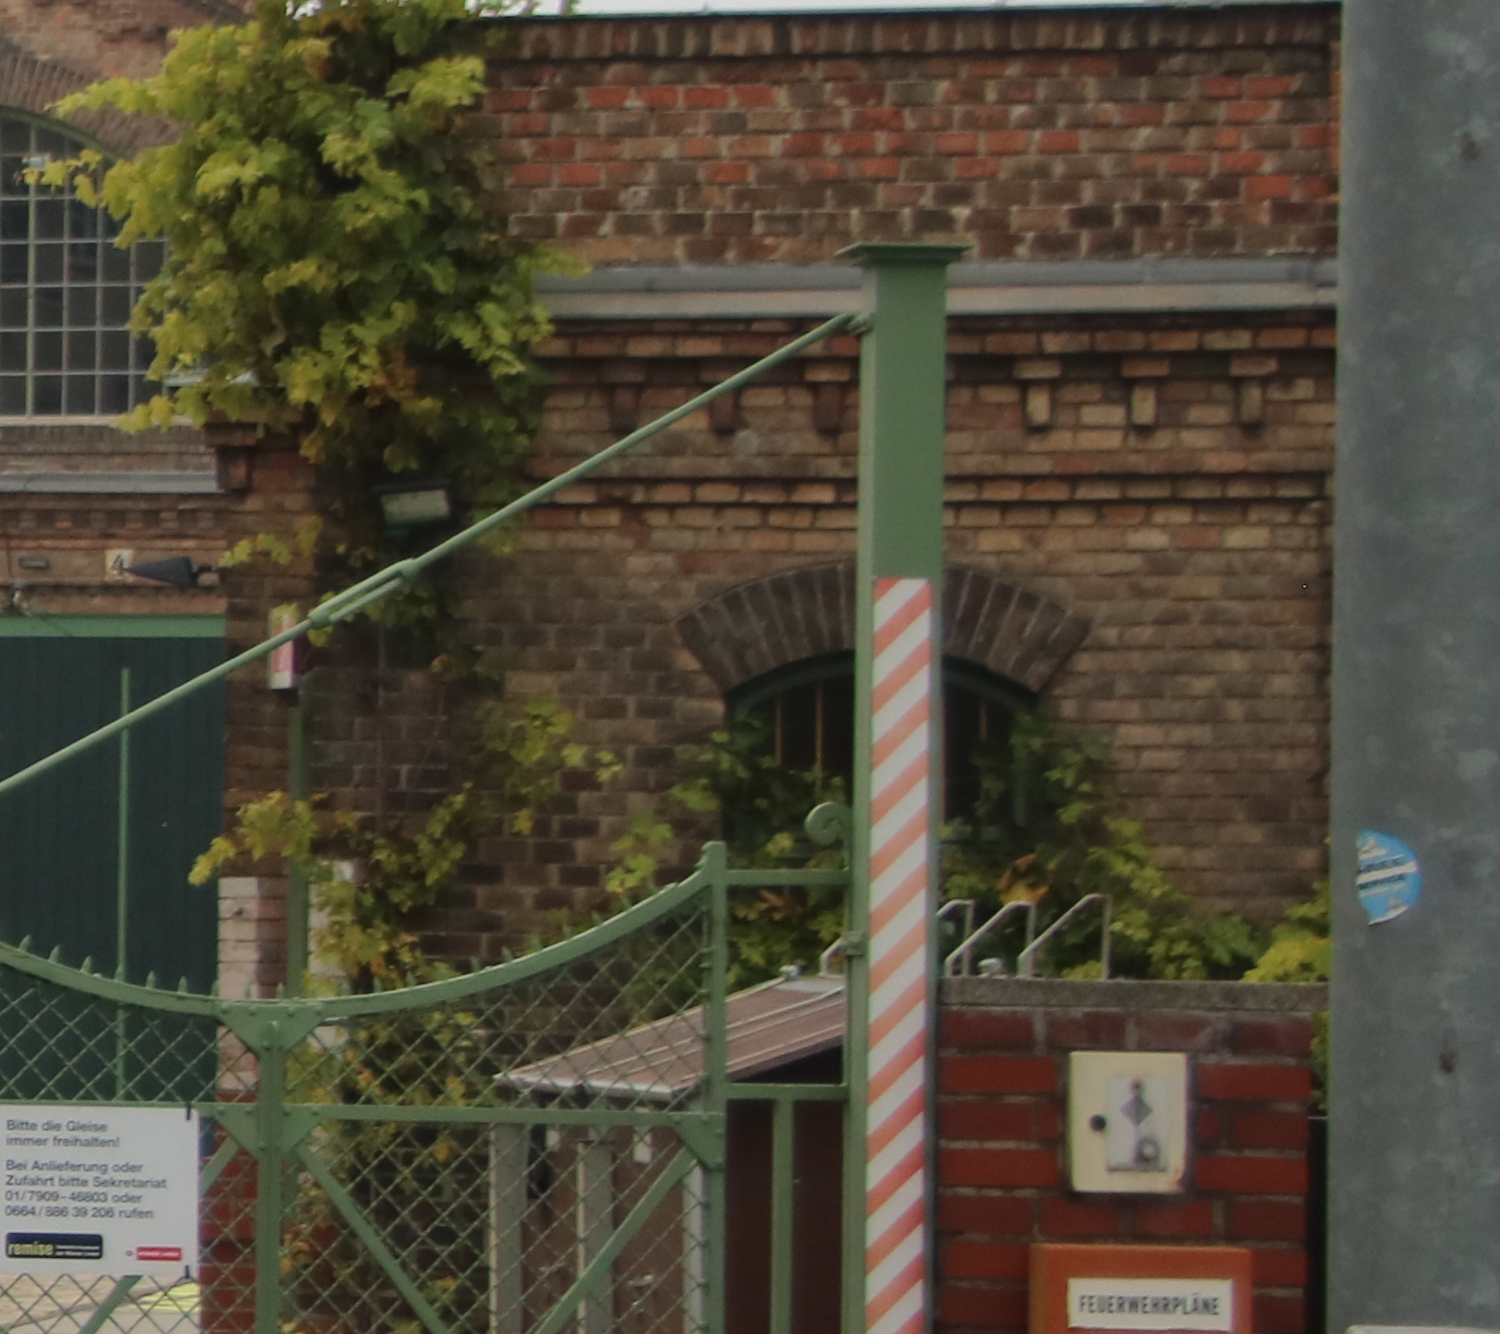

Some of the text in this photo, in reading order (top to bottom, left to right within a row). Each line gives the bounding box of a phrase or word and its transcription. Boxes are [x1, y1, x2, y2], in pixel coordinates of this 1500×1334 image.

[111, 554, 125, 575] 4
[6, 1119, 108, 1132] Bitte die Gleise
[6, 1135, 120, 1147] immer freihalten!
[6, 1160, 143, 1174] Bei Anlieferung oder
[5, 1175, 167, 1188] Zufahrt bitte Sekretariat
[111, 1192, 143, 1203] oder
[72, 1206, 88, 1218] 39
[91, 1207, 115, 1218] 206
[118, 1207, 155, 1219] rufen
[8, 1241, 54, 1256] remise
[1079, 1292, 1220, 1316] FEUERWEHRPLÄNE
